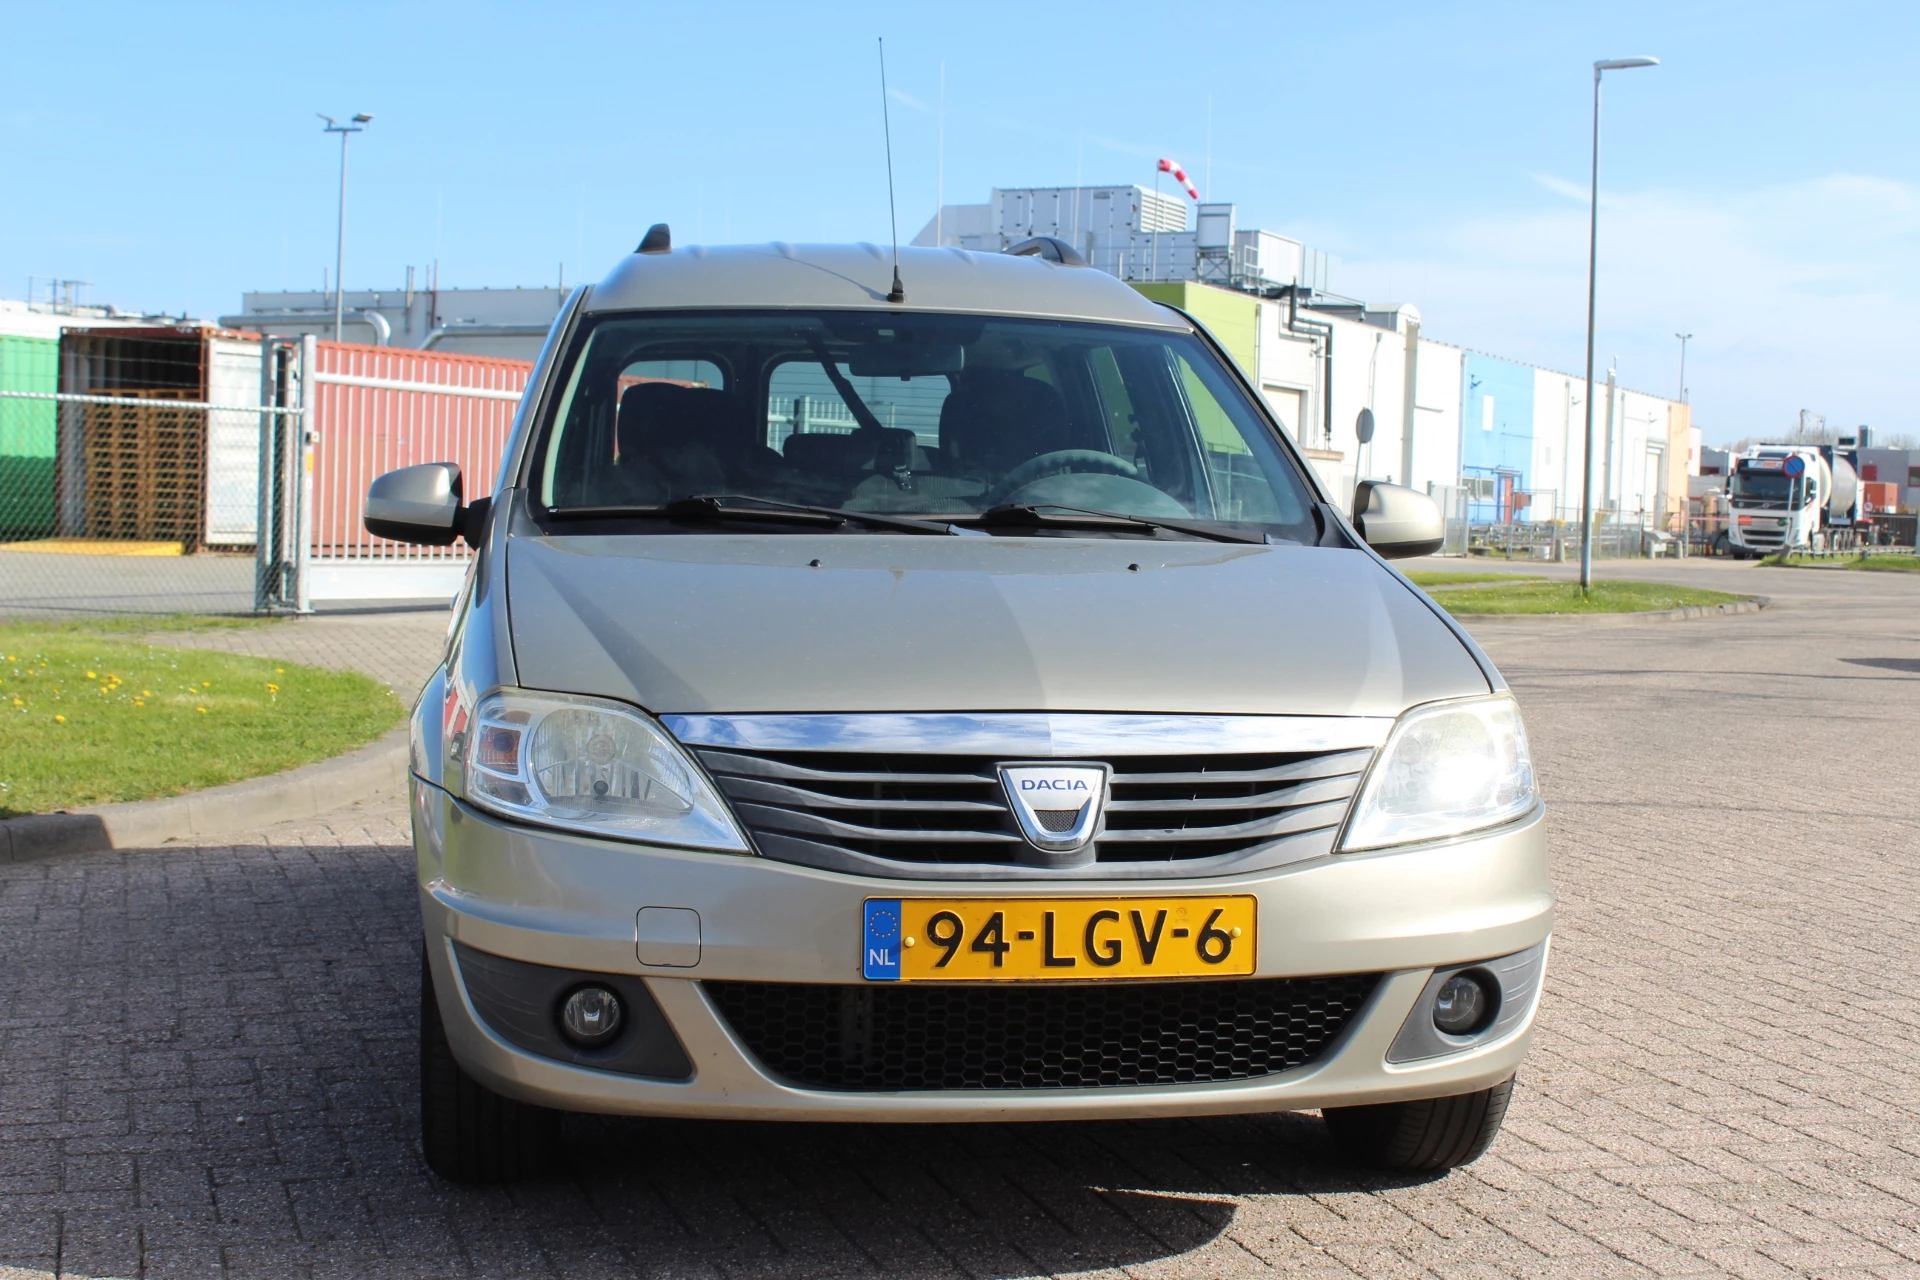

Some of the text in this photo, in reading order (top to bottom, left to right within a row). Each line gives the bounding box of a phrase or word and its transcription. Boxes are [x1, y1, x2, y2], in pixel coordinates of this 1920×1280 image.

[1021, 779, 1088, 790] DACIA
[926, 909, 1233, 967] 94-LGV-6
[869, 949, 895, 966] NL
